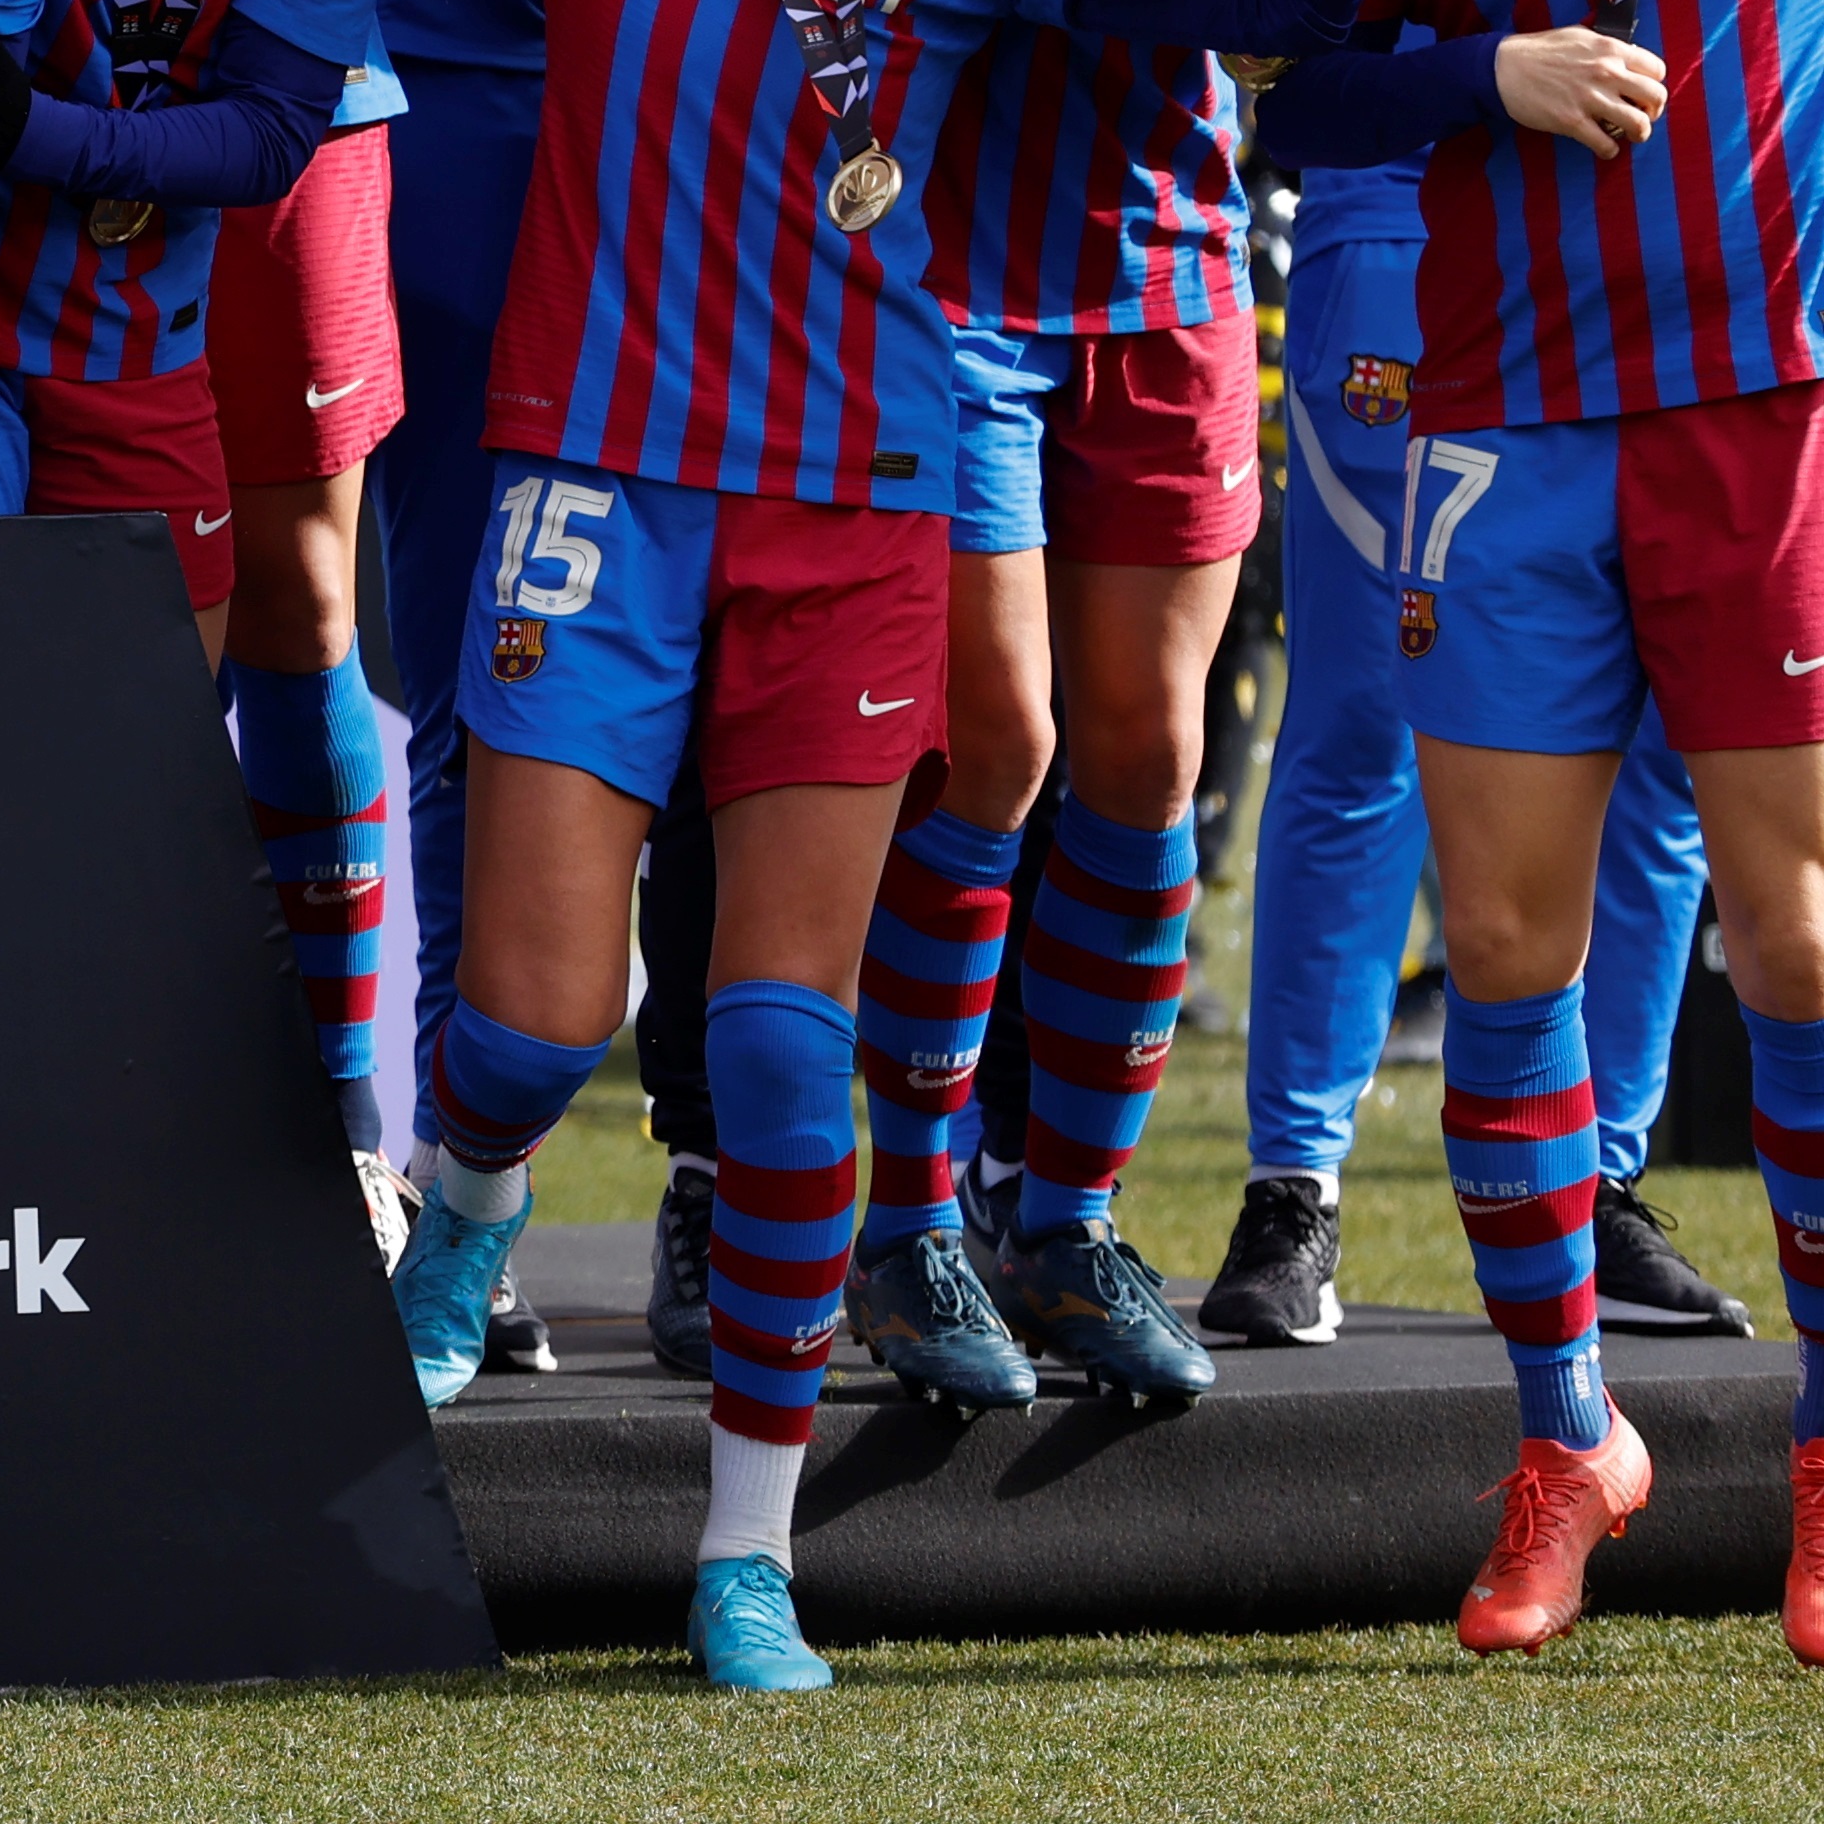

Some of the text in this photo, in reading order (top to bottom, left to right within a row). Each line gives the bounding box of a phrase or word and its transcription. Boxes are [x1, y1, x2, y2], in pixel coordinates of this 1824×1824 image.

[1399, 436, 1499, 583] 17
[495, 477, 614, 616] 15
[507, 645, 526, 654] FCB
[305, 862, 376, 879] CULERS
[1452, 1175, 1528, 1196] CULERS
